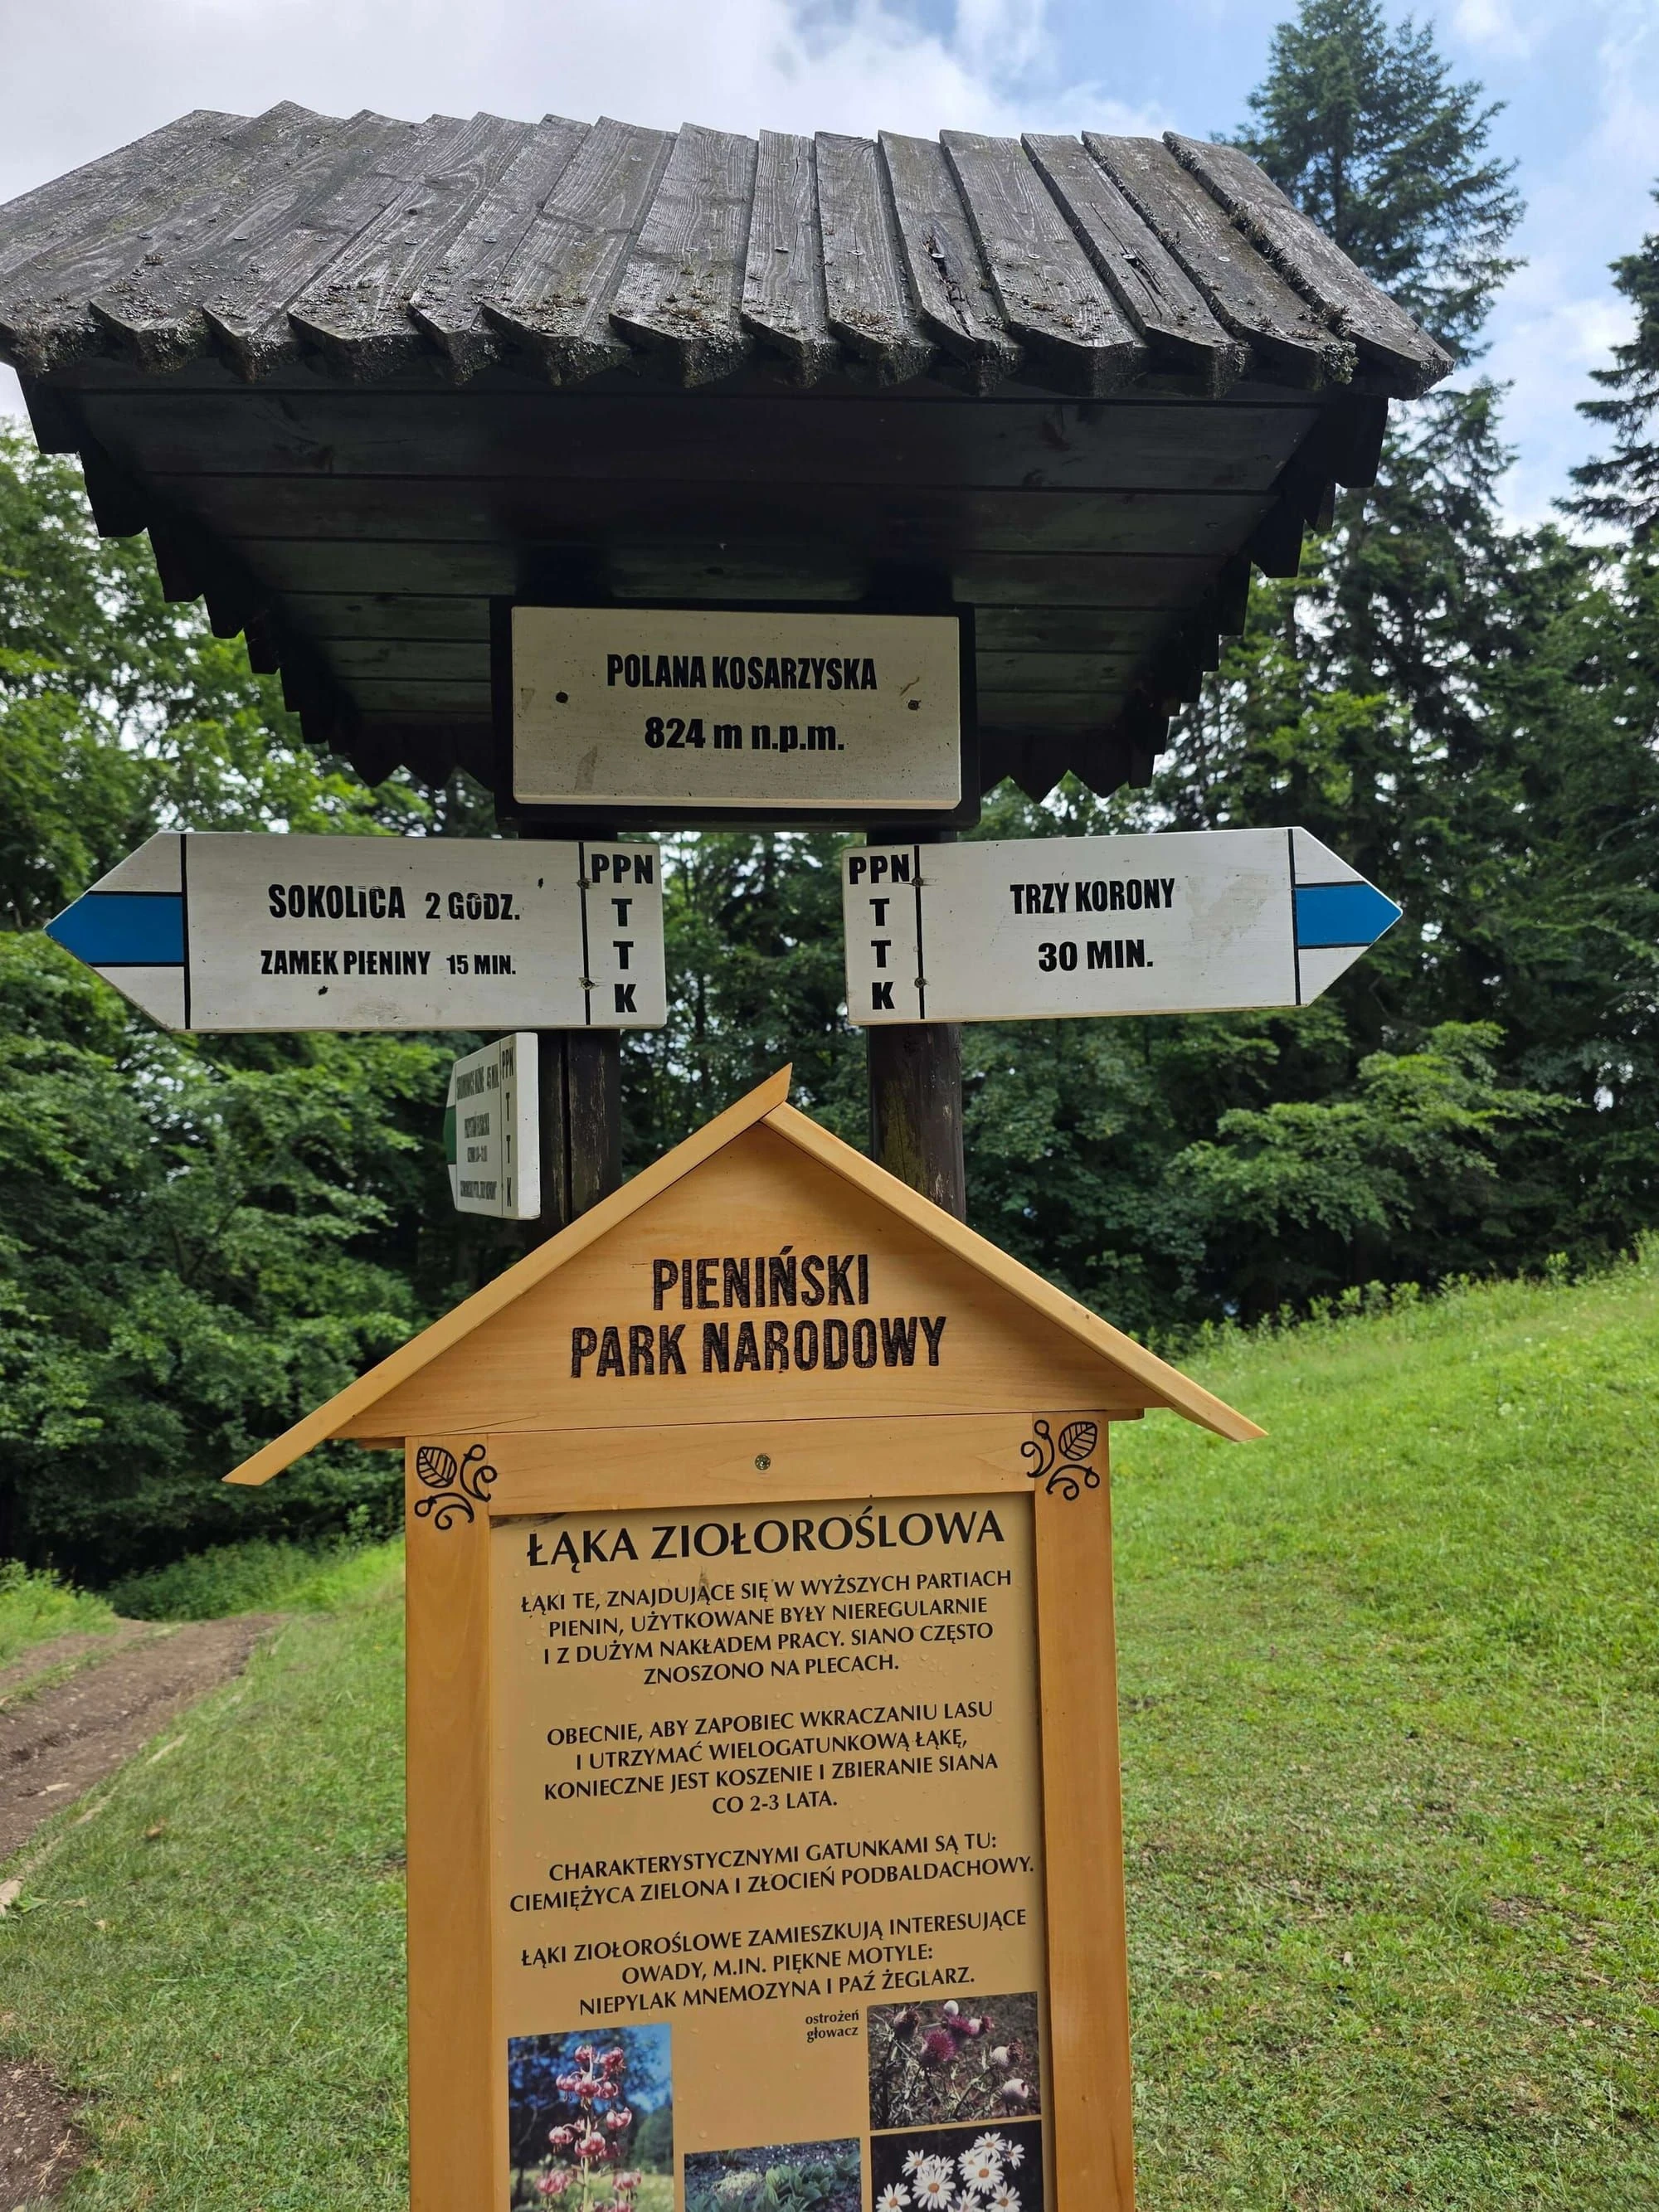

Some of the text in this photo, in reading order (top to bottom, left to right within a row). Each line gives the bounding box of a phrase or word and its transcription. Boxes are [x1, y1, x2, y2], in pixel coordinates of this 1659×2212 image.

[607, 654, 877, 690] POLANA KOSARZYSKA
[645, 717, 844, 752] 824 m n.p.m.
[591, 854, 653, 884] PPN
[849, 854, 909, 884] PPN
[269, 884, 519, 920] SOKOLICA 2 GODZ.
[1010, 878, 1175, 914] TRZY KORONY
[261, 950, 516, 975] ZAMEK PIENINY 15 MIN.
[1039, 940, 1153, 972] 30 MIN.
[653, 1246, 868, 1310] PIENIŃSKI
[571, 1316, 946, 1378] PARK NARODOWY
[527, 1505, 1005, 1573] ŁĄKA ZIOŁOROŚLOWA
[521, 1570, 1010, 1618] ŁĄKI TE, ZNAJDUJĄCE SIĘ W WYŻSZYCH PARTIACH
[550, 1597, 987, 1643] PIENIN, UŻYTKOWANE BYŁY NIEREGULARNIE
[544, 1623, 993, 1665] I Z DUŻYM NAKŁADEM PRACY. SIANO CZĘSTO
[644, 1655, 898, 1685] ZNOSZONO NA PLECACH.
[547, 1701, 991, 1745] OBECNIE, ABY ZAPOBIEC WKRACZANIU LASU
[577, 1729, 966, 1771] I UTRZYMAĆ WIELOGATUNKOWĄ ŁĄKĘ,
[545, 1753, 998, 1800] KONIECZNE JEST KOSZENIE I ZBIERANIE SIANA
[713, 1791, 837, 1814] CO 2-3 LATA.
[550, 1833, 995, 1881] CHARAKTERYSTYCZNYMI GATUNKAMI SĄ TU:
[510, 1856, 1034, 1912] CIEMIĘŻYCA ZIELONA I ZŁOCIEŃ PODBALDACHOWY.
[522, 1909, 1026, 1968] ŁĄKI ZIOŁOROŚLOWE ZAMIESZKUJĄ INTERESUJĄCE
[622, 1944, 932, 1984] OWADY, M.IN. PIĘKNE MOTYLE:
[581, 1966, 974, 2015] NIEPYLAK MNEMOZYNA I PAŹ ŻEGLARZ.
[805, 2010, 859, 2025] ostrożeń
[807, 2027, 858, 2043] głowacz
